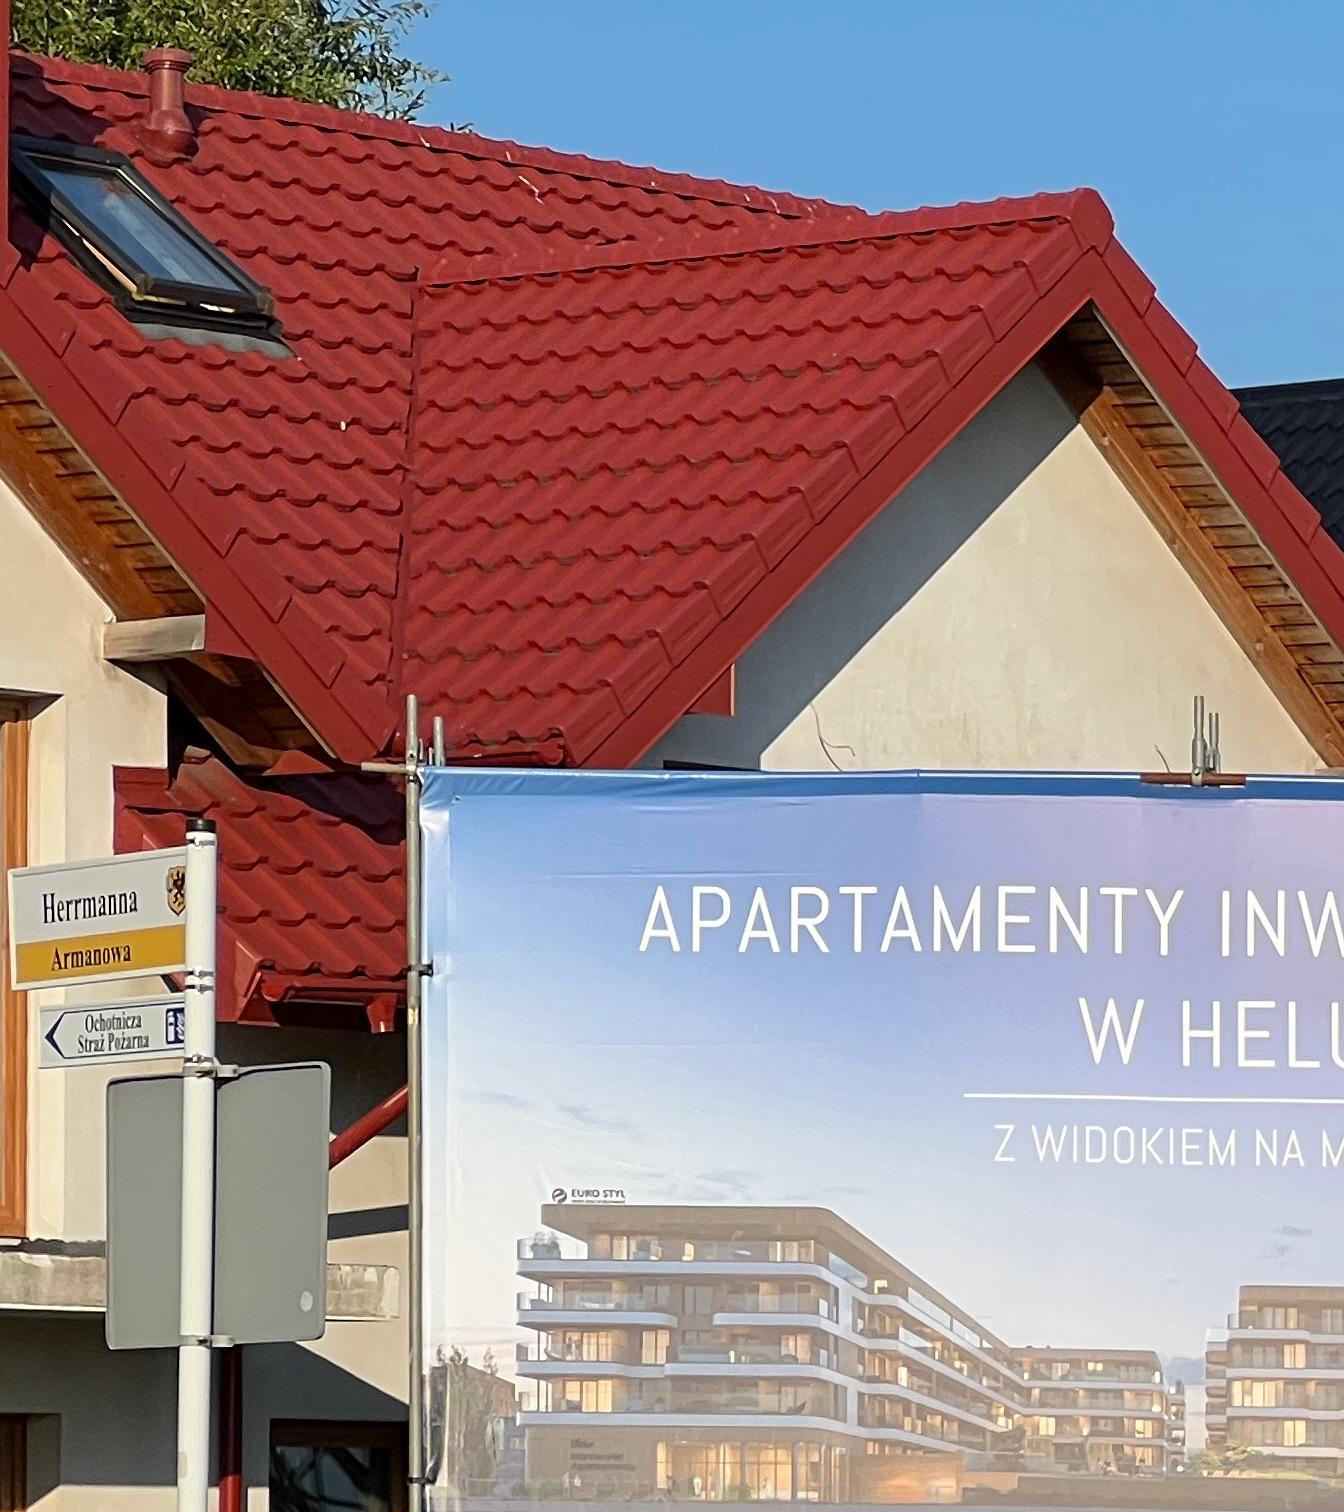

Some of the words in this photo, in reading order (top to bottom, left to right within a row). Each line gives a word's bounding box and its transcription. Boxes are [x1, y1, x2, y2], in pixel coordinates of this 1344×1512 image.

[42, 889, 138, 924] Herrmanna
[639, 885, 1184, 957] APARTAMENTY
[51, 943, 132, 971] Armanowa
[84, 1011, 142, 1033] Ochotnicza
[1078, 997, 1144, 1066] W
[77, 1032, 105, 1053] Straż
[108, 1030, 150, 1052] Pożarna
[993, 1124, 1015, 1163] Z
[1031, 1125, 1236, 1168] WIDOKIEM
[1255, 1129, 1306, 1168] NA
[571, 1188, 600, 1198] EURO
[602, 1189, 626, 1199] STYL
